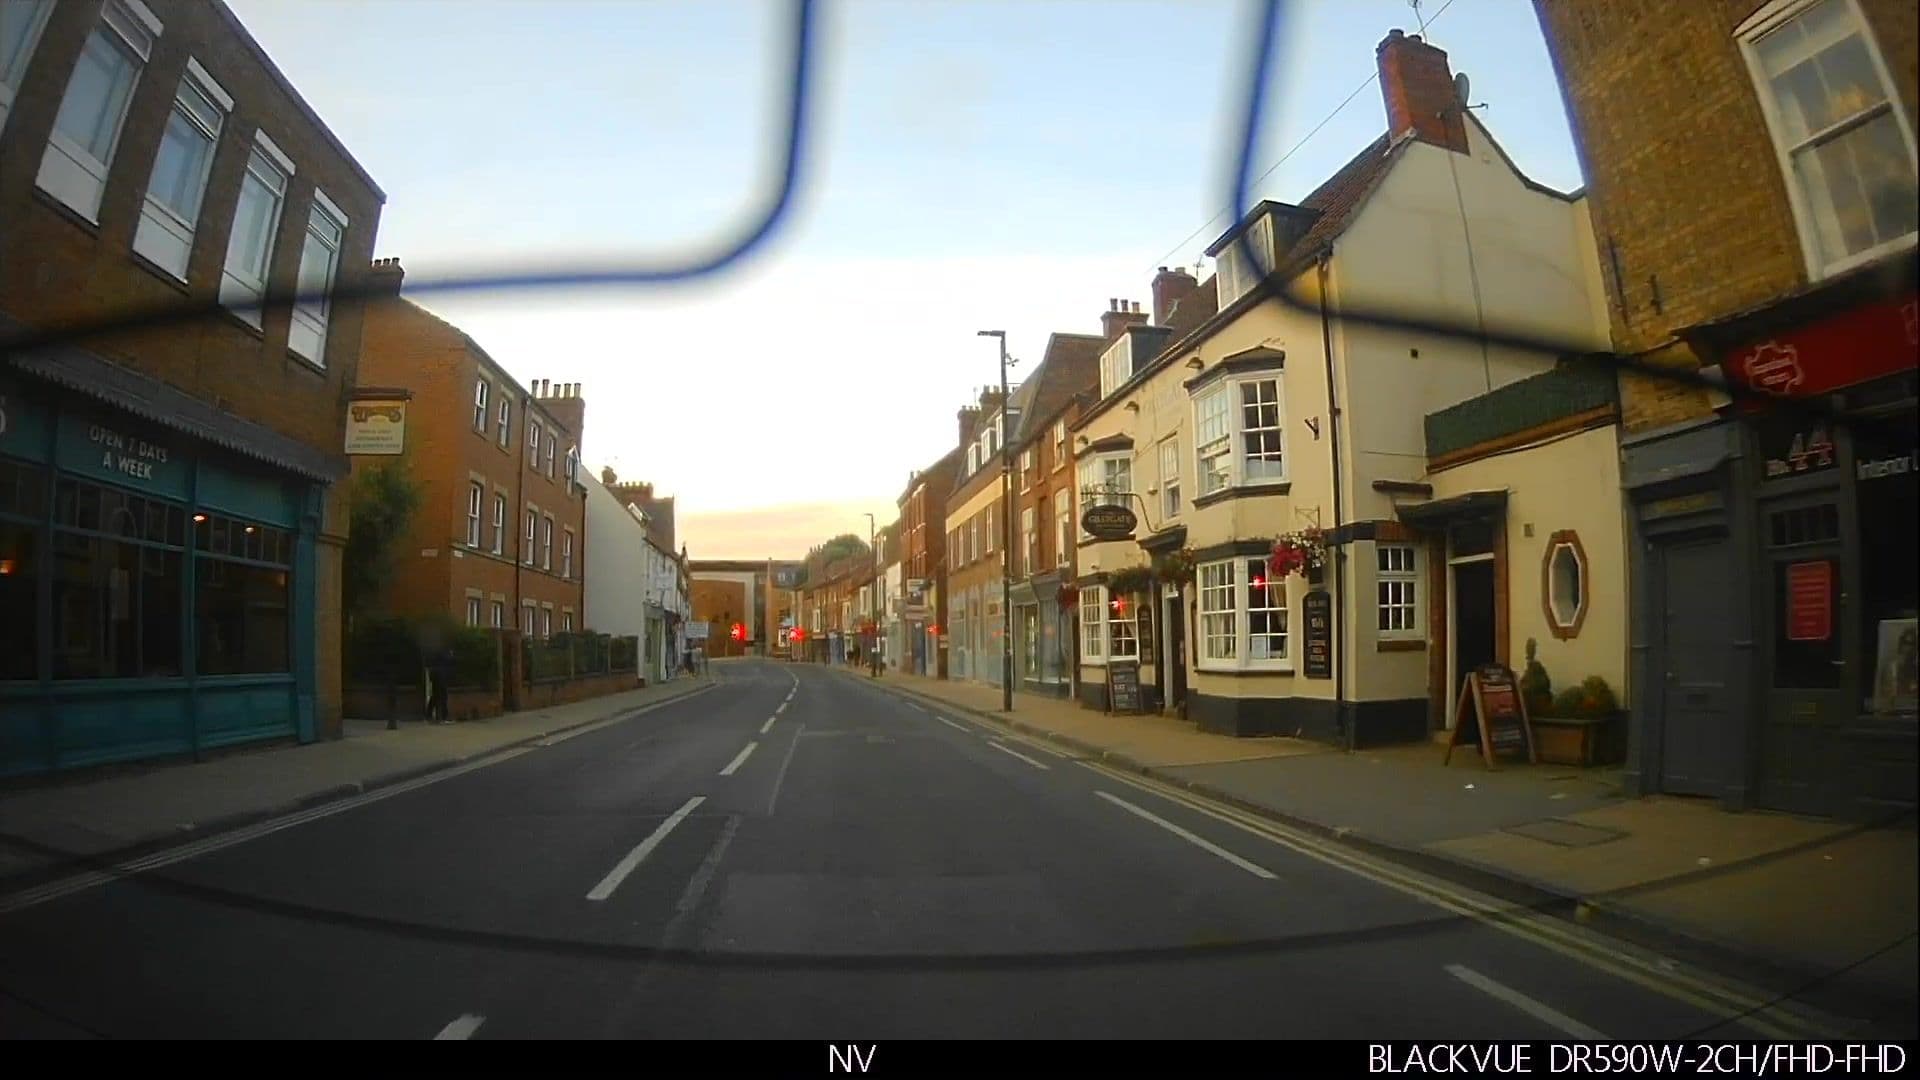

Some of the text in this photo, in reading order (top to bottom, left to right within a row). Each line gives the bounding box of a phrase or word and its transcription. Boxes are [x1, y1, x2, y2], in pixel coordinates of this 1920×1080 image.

[89, 424, 168, 463] OPEN 7 DAYS
[1789, 423, 1832, 470] 44
[102, 451, 152, 480] A WEEK
